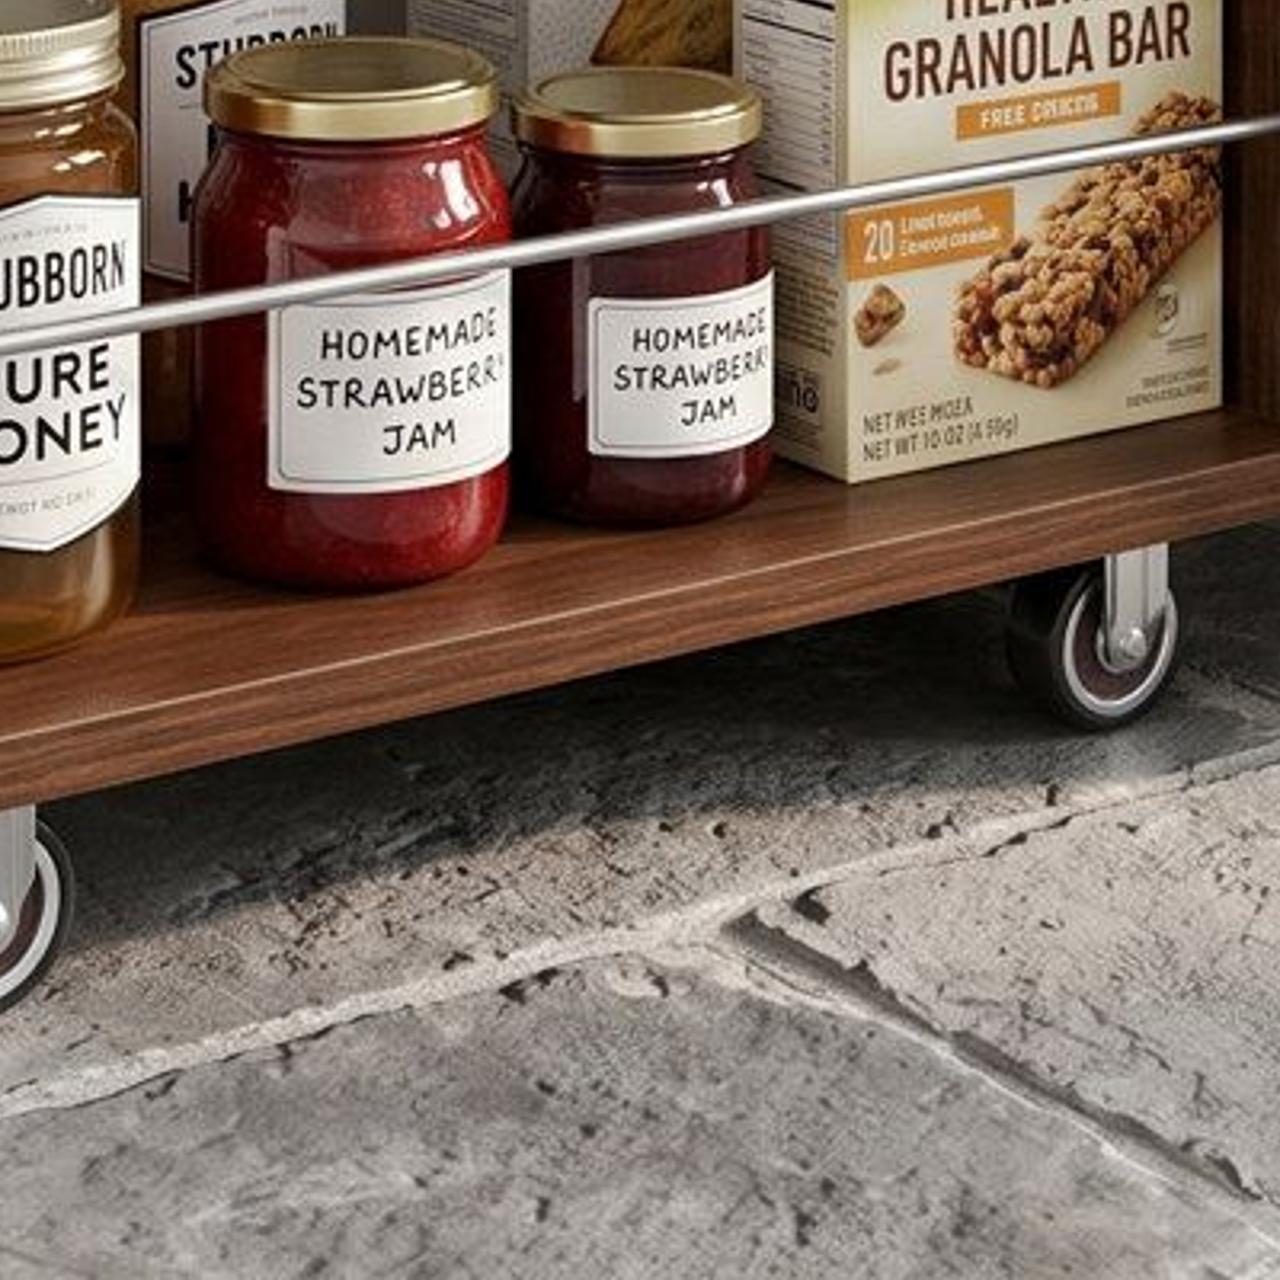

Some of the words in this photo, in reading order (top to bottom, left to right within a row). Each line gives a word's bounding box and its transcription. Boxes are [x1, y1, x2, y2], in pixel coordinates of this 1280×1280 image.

[884, 13, 1094, 103] GRANOLA
[1108, 1, 1193, 68] BAR
[979, 104, 1026, 130] FREE
[864, 220, 894, 263] 20
[320, 307, 496, 360] HOMEMADE
[633, 307, 766, 353] HOMEMADE
[681, 396, 737, 427] JAM
[863, 412, 892, 435] NET
[383, 419, 456, 456] JAM
[863, 438, 891, 462] NET
